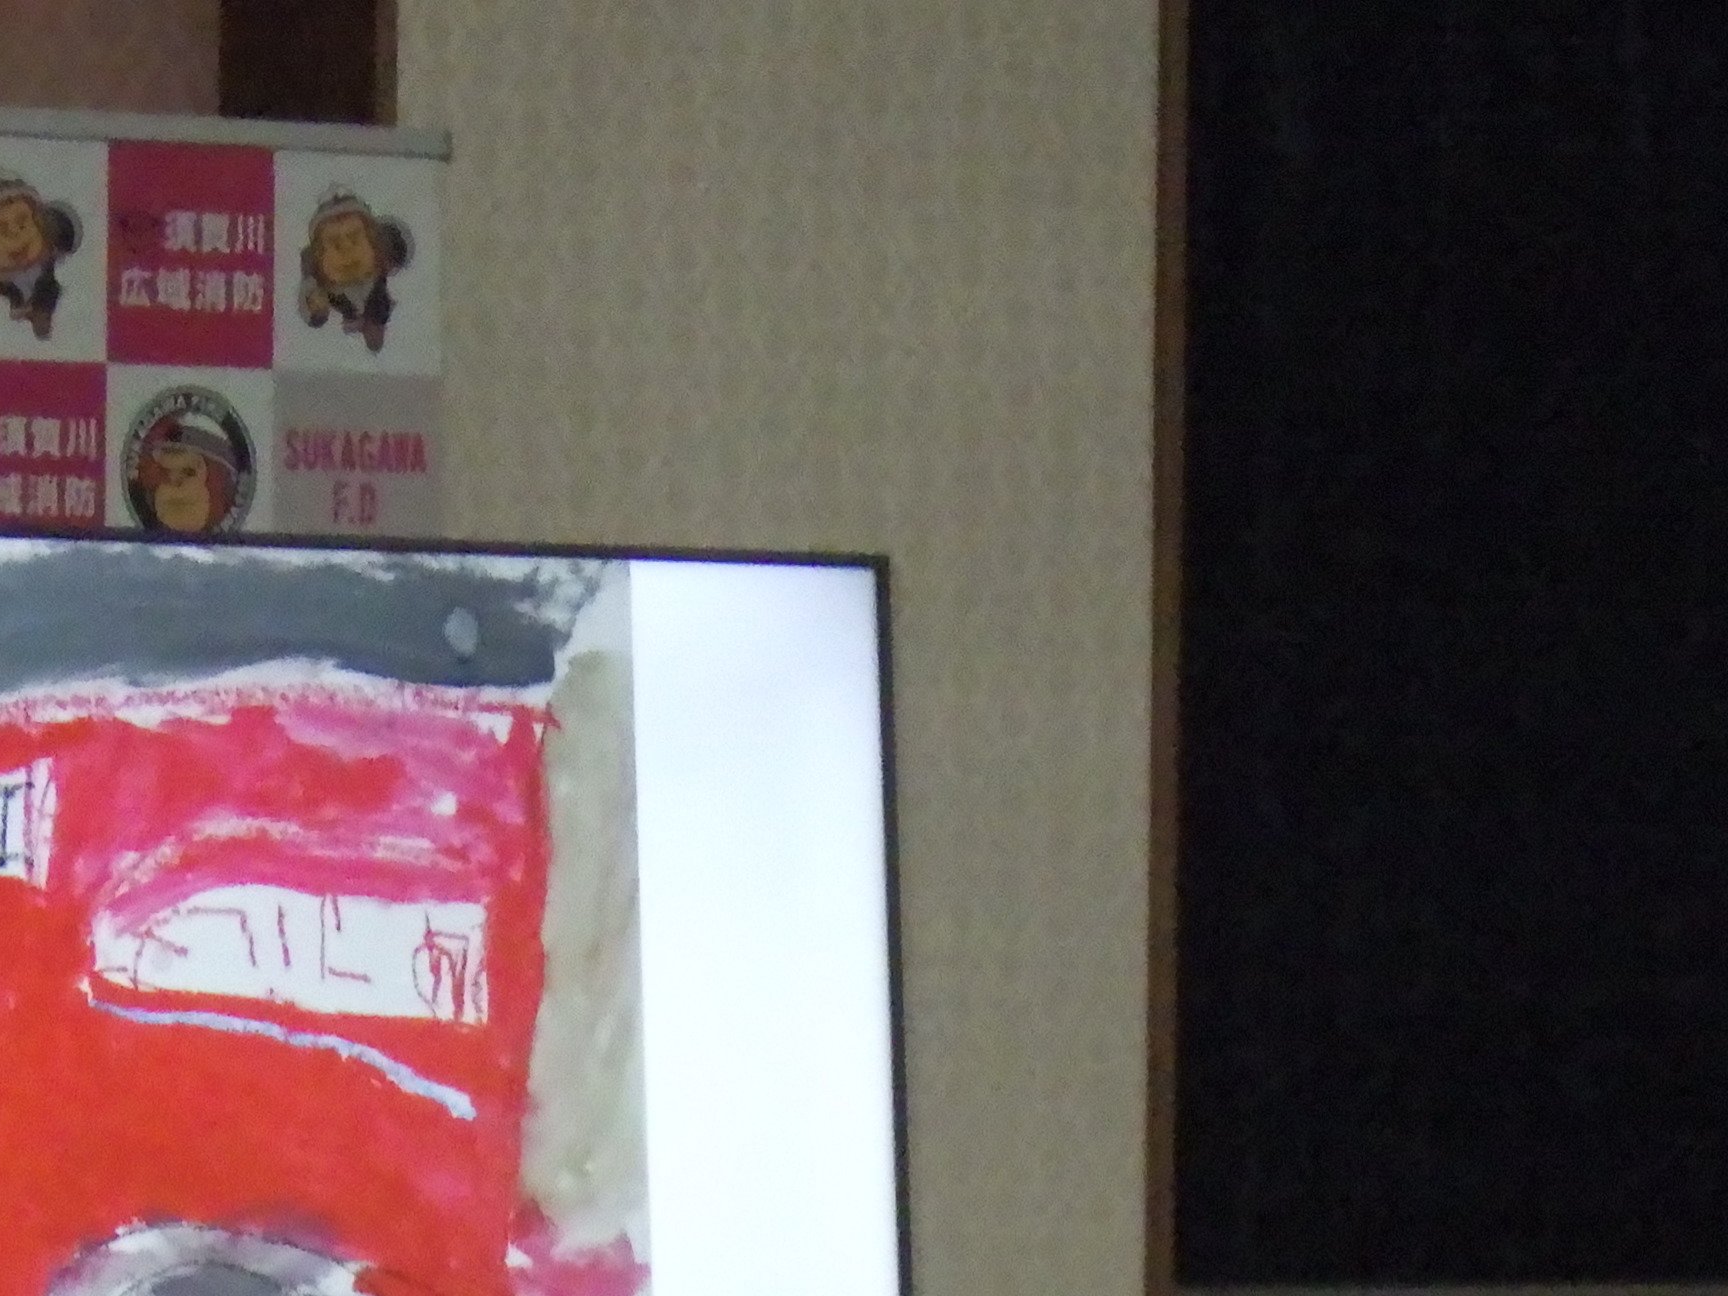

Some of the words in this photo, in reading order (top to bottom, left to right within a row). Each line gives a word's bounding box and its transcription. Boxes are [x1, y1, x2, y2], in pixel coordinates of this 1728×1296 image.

[165, 211, 264, 254] 須賀川
[120, 268, 263, 313] 広域消防
[284, 430, 427, 474] SUKAGAWA
